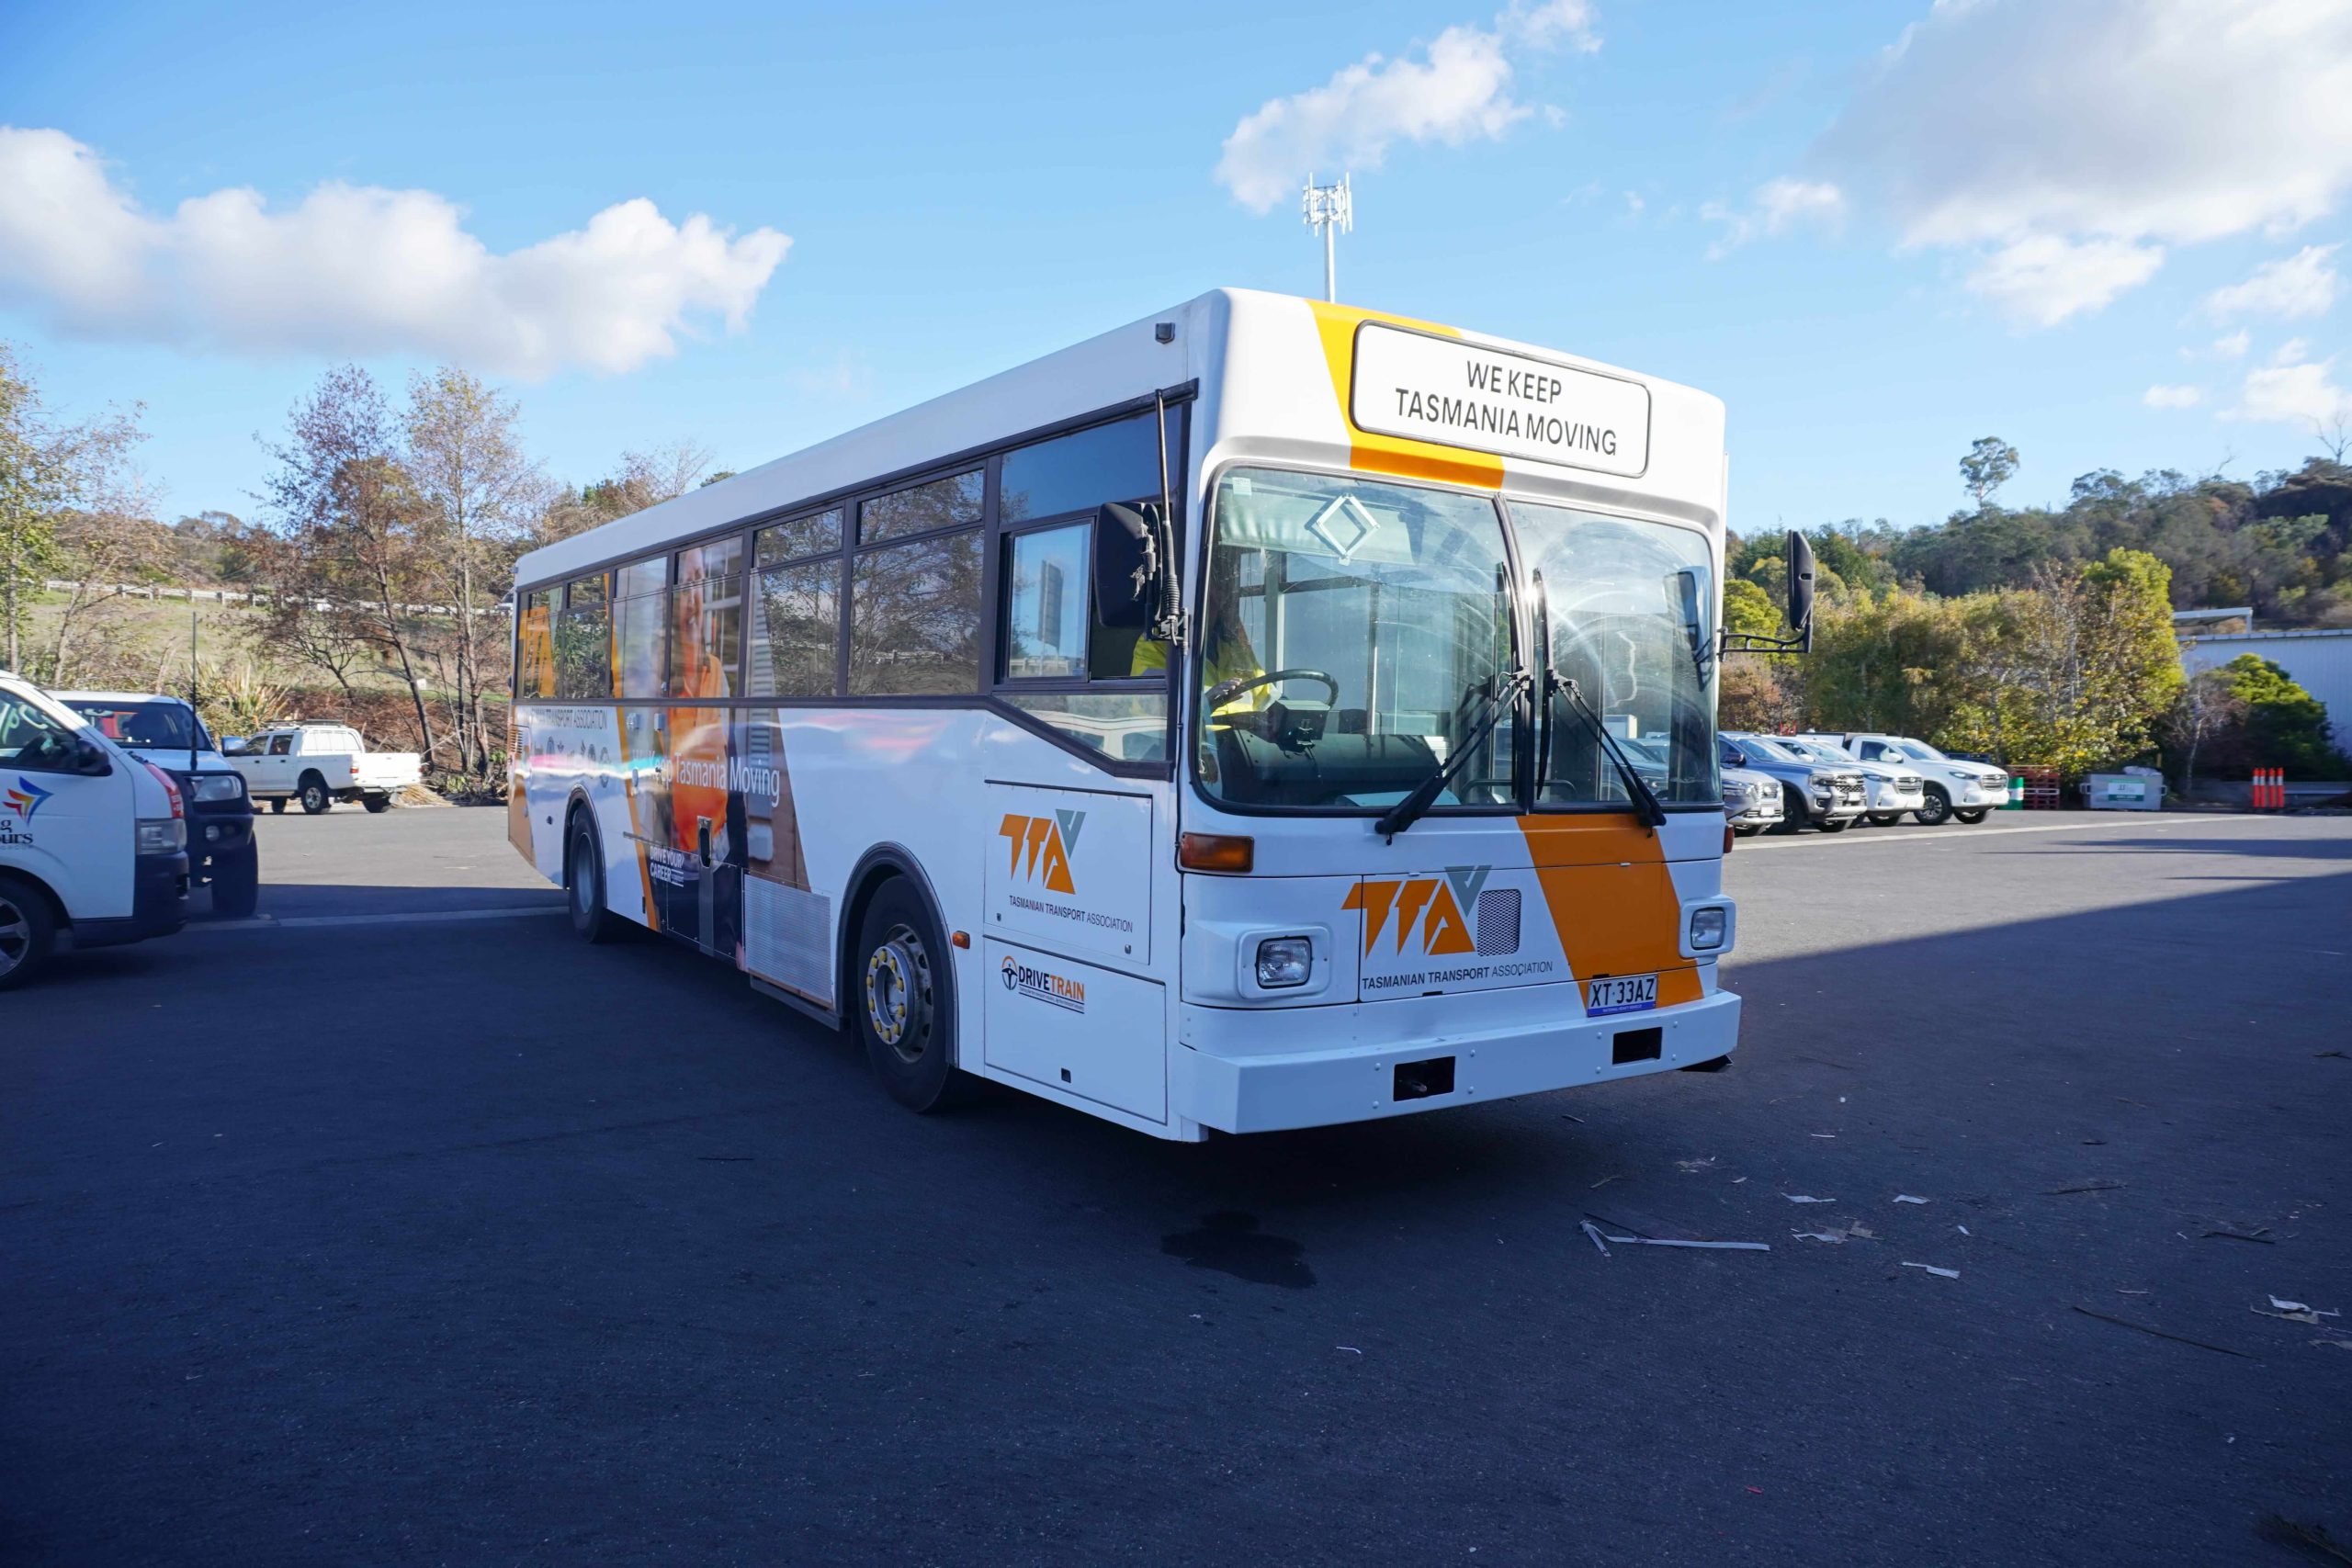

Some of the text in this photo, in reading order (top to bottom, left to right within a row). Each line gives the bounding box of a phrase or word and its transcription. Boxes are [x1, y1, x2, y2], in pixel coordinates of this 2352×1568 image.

[1467, 360, 1562, 404] WE KEEP
[1395, 388, 1617, 457] TASMANIA MOVING
[674, 751, 727, 790] Tasmania
[729, 756, 780, 807] Moving
[650, 845, 682, 868] DRIVE YOUR
[650, 862, 672, 883] CAREER
[1009, 895, 1134, 933] TASMANIAN TRANSPORT ASSOCIATION
[1018, 965, 1085, 1001] DRIVETRAIN
[1362, 961, 1554, 990] TASMANIAN TRANSPORT ASSOCIATION
